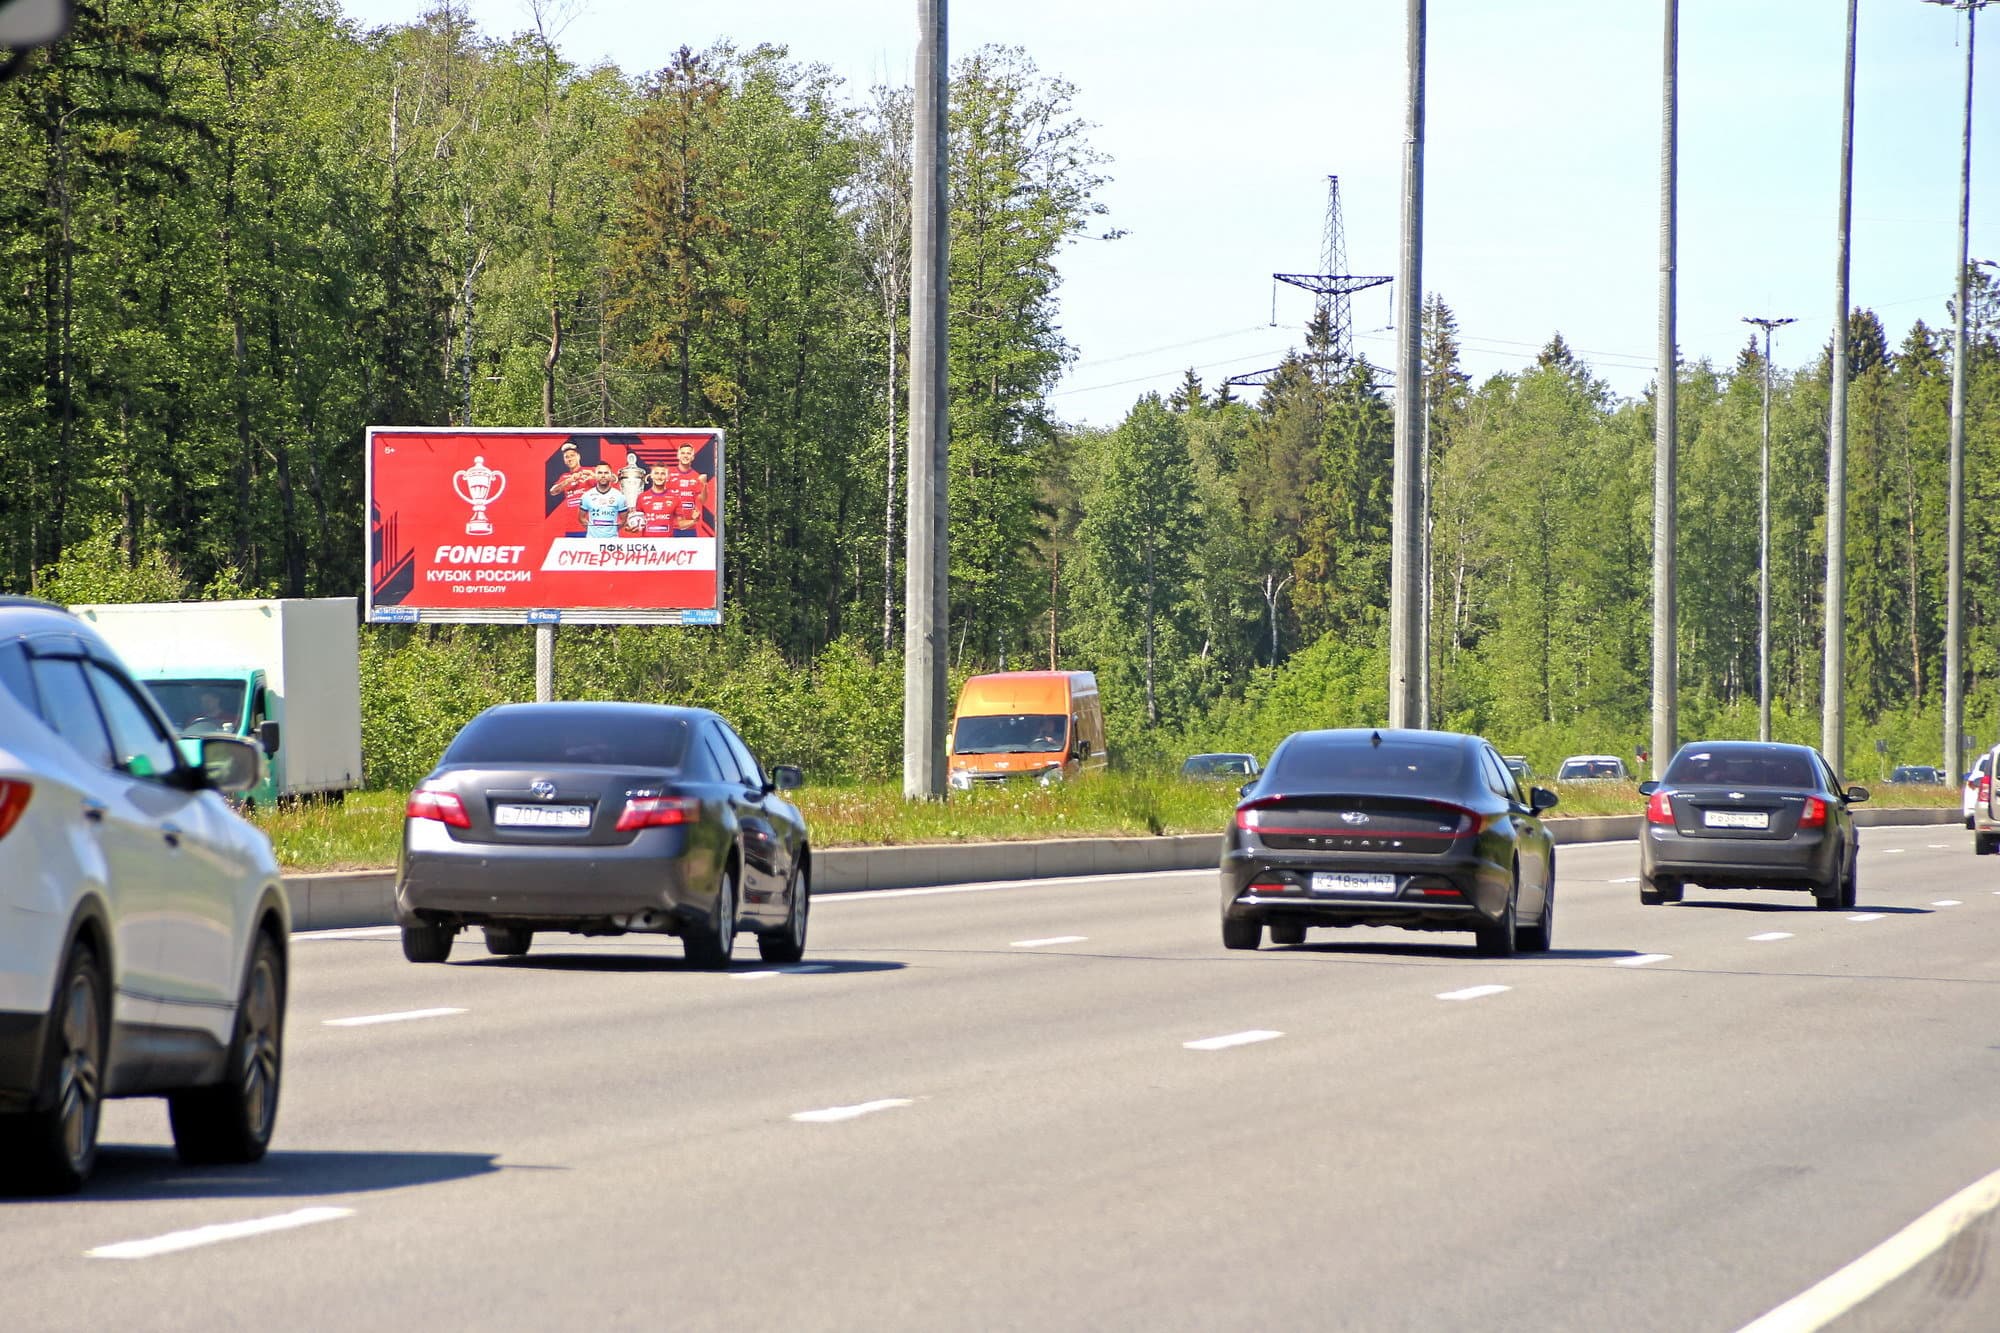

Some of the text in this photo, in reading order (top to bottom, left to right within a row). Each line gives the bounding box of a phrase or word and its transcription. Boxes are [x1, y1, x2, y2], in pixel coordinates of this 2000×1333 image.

[599, 543, 657, 552] ПФК ЦСКА
[434, 545, 526, 564] FONBET
[558, 550, 699, 566] СУПЕРФИНАЛИСТ
[426, 570, 531, 582] КУБОК РОССИИ
[452, 585, 507, 593] ПО ФУТБОЛУ
